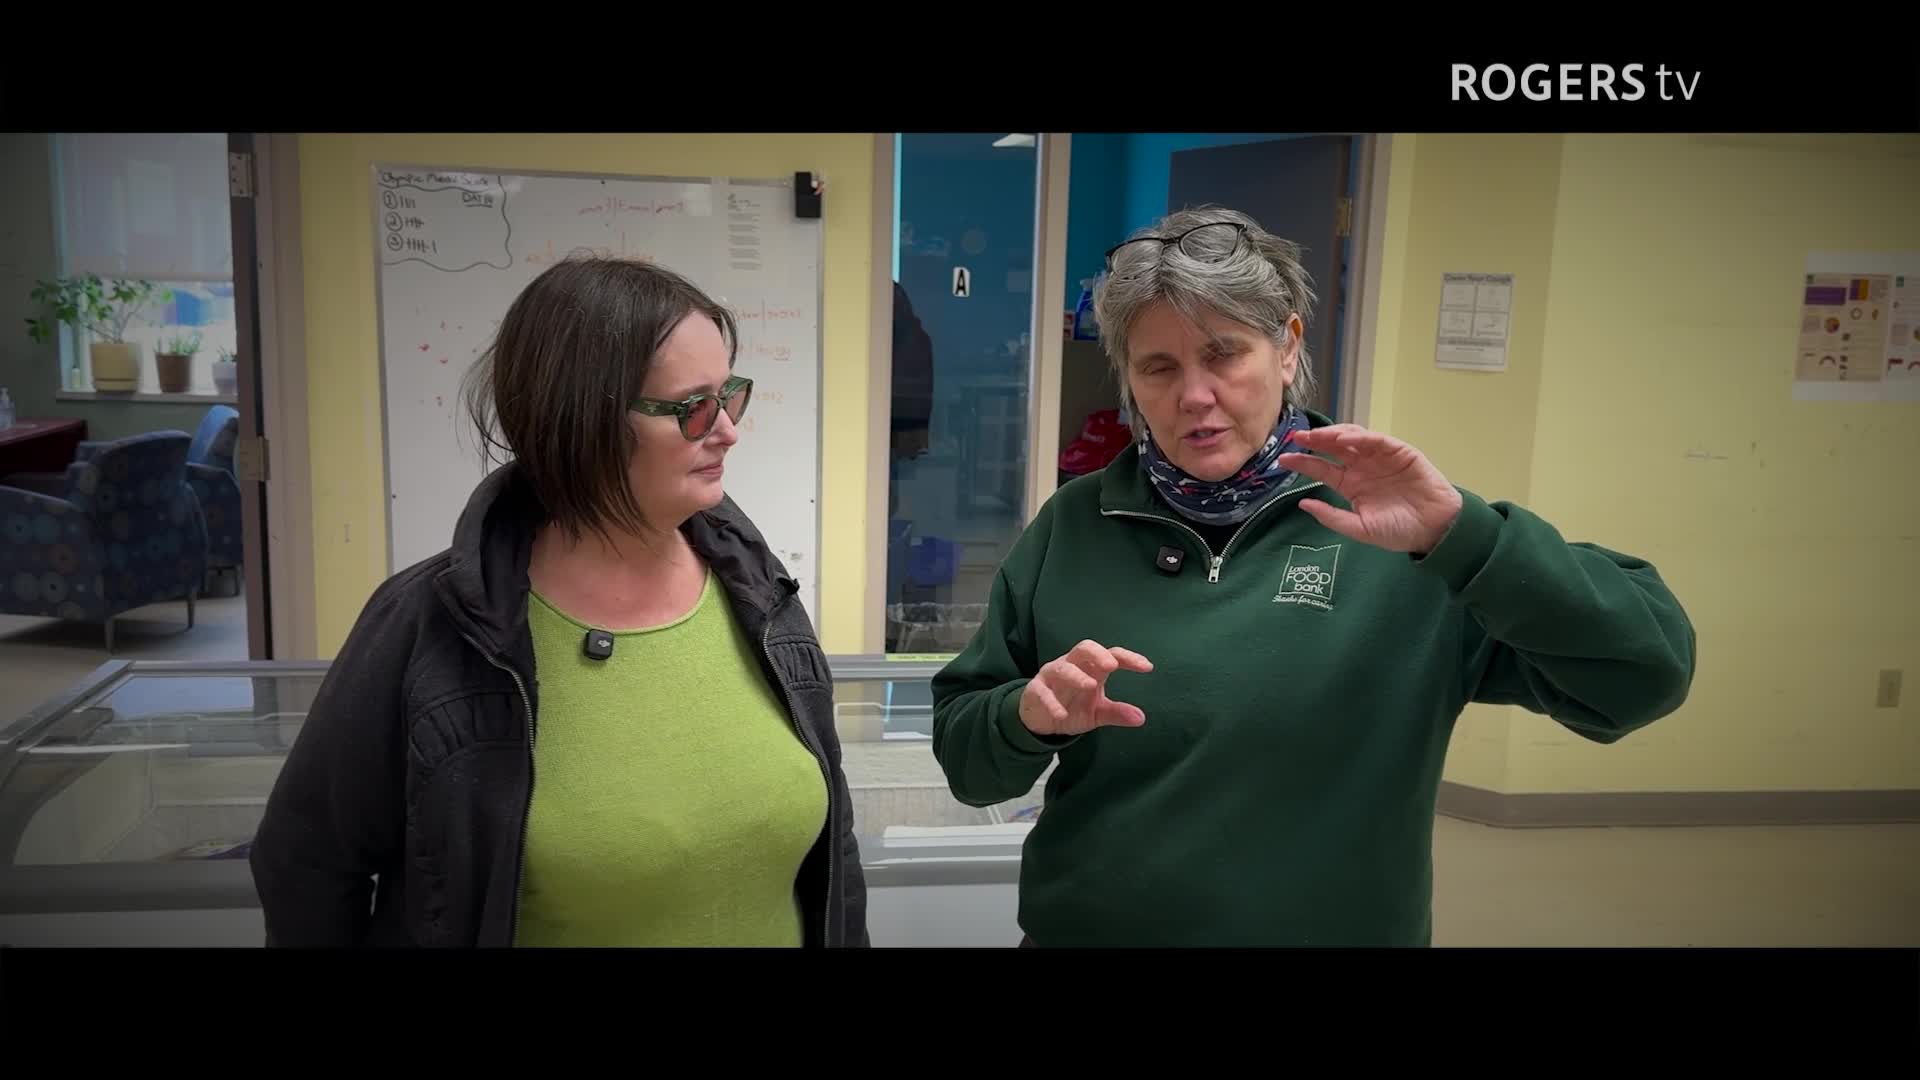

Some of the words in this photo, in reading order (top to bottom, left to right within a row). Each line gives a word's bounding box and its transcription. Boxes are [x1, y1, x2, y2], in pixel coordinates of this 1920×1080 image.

[955, 269, 967, 295] A
[1286, 572, 1331, 584] FOOD
[1294, 583, 1323, 594] bank
